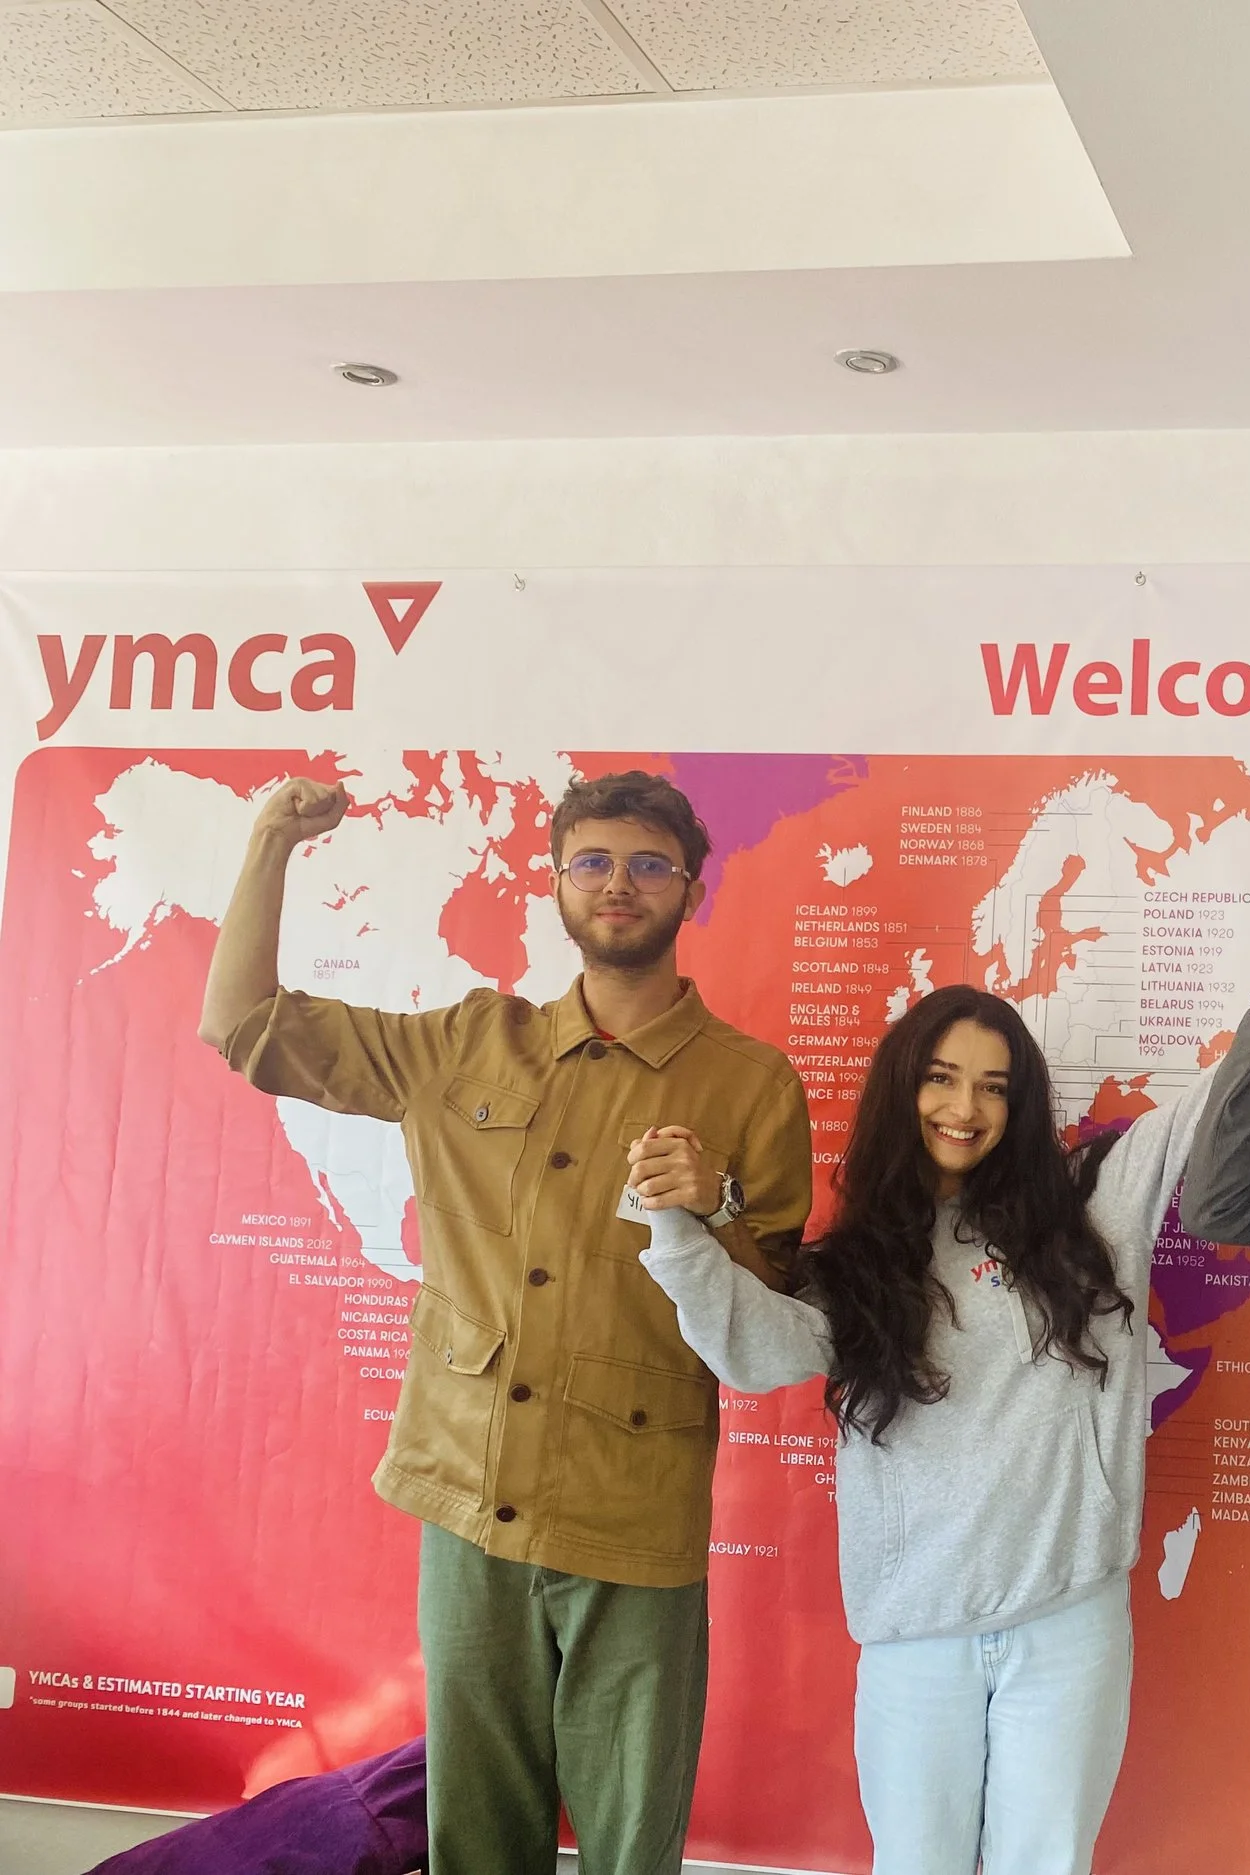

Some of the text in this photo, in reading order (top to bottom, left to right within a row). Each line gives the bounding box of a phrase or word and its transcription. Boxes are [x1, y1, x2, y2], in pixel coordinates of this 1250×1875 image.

[36, 632, 356, 741] ymca
[901, 806, 982, 817] FINLAND 1886
[900, 823, 981, 834] SWEDEN 1884
[900, 839, 985, 851] NORWAY 1868
[899, 854, 988, 866] DENMARK 1878
[1144, 891, 1188, 903] CZECH
[796, 905, 878, 917] ICELAND 1899
[1143, 909, 1225, 921] POLAND 1923
[795, 921, 907, 933] NETHERLANDS 1851
[1143, 927, 1234, 939] SLOVAKIA 1920
[794, 936, 878, 949] BELGIUM 1853
[1142, 945, 1223, 957] ESTONIA 1919
[313, 959, 360, 969] CANADA
[792, 962, 889, 974] SCOTLAND 1848
[1141, 962, 1214, 974] LATVIA 1923
[791, 982, 872, 994] IRELAND 1849
[1141, 980, 1235, 993] LITHUANIA 1932
[790, 1004, 860, 1016] ENGLAND &
[1140, 999, 1224, 1011] BELARUS 1994
[789, 1015, 860, 1026] WALES 1844
[1139, 1016, 1222, 1028] UKRAINE 1993
[788, 1034, 879, 1047] GERMANY 1848
[1139, 1034, 1202, 1046] MOLDOVA
[1139, 1046, 1165, 1057] 1996
[787, 1054, 872, 1067] SWITZERLAND
[799, 1071, 835, 1083] STRIA
[807, 1089, 833, 1100] NCE
[821, 1121, 849, 1132] 1880
[241, 1214, 311, 1228] MEXICO 1891
[209, 1233, 333, 1250] CAYMEN ISLANDS 2012
[1156, 1238, 1191, 1250] RDAN
[270, 1253, 366, 1268] GUATEMALA 1964
[1151, 1254, 1205, 1267] AZA 1952
[289, 1273, 393, 1289] EL SALVADOR 1990
[344, 1294, 408, 1307] HONDURAS
[341, 1312, 409, 1325] NICARAGUA
[338, 1328, 377, 1341] COSTA
[380, 1331, 408, 1342] RICA
[343, 1345, 390, 1358] PANAMA
[360, 1367, 405, 1380] COLOM
[732, 1400, 758, 1412] 1972
[364, 1409, 396, 1421] ECUA
[728, 1432, 770, 1445] SIERRA
[774, 1434, 814, 1447] LEONE
[780, 1453, 825, 1466] LIBERIA
[708, 1541, 778, 1558] AGUAY 1921
[29, 1670, 305, 1709] YMCAs & ESTIMATED STARTING YEAR
[58, 1700, 88, 1711] groups
[91, 1702, 123, 1713] started
[125, 1704, 154, 1716] before
[157, 1707, 180, 1718] 1844
[182, 1710, 199, 1719] and
[201, 1711, 222, 1721] later
[224, 1713, 262, 1726] changed
[264, 1717, 274, 1726] to
[276, 1718, 303, 1729] YMCA
